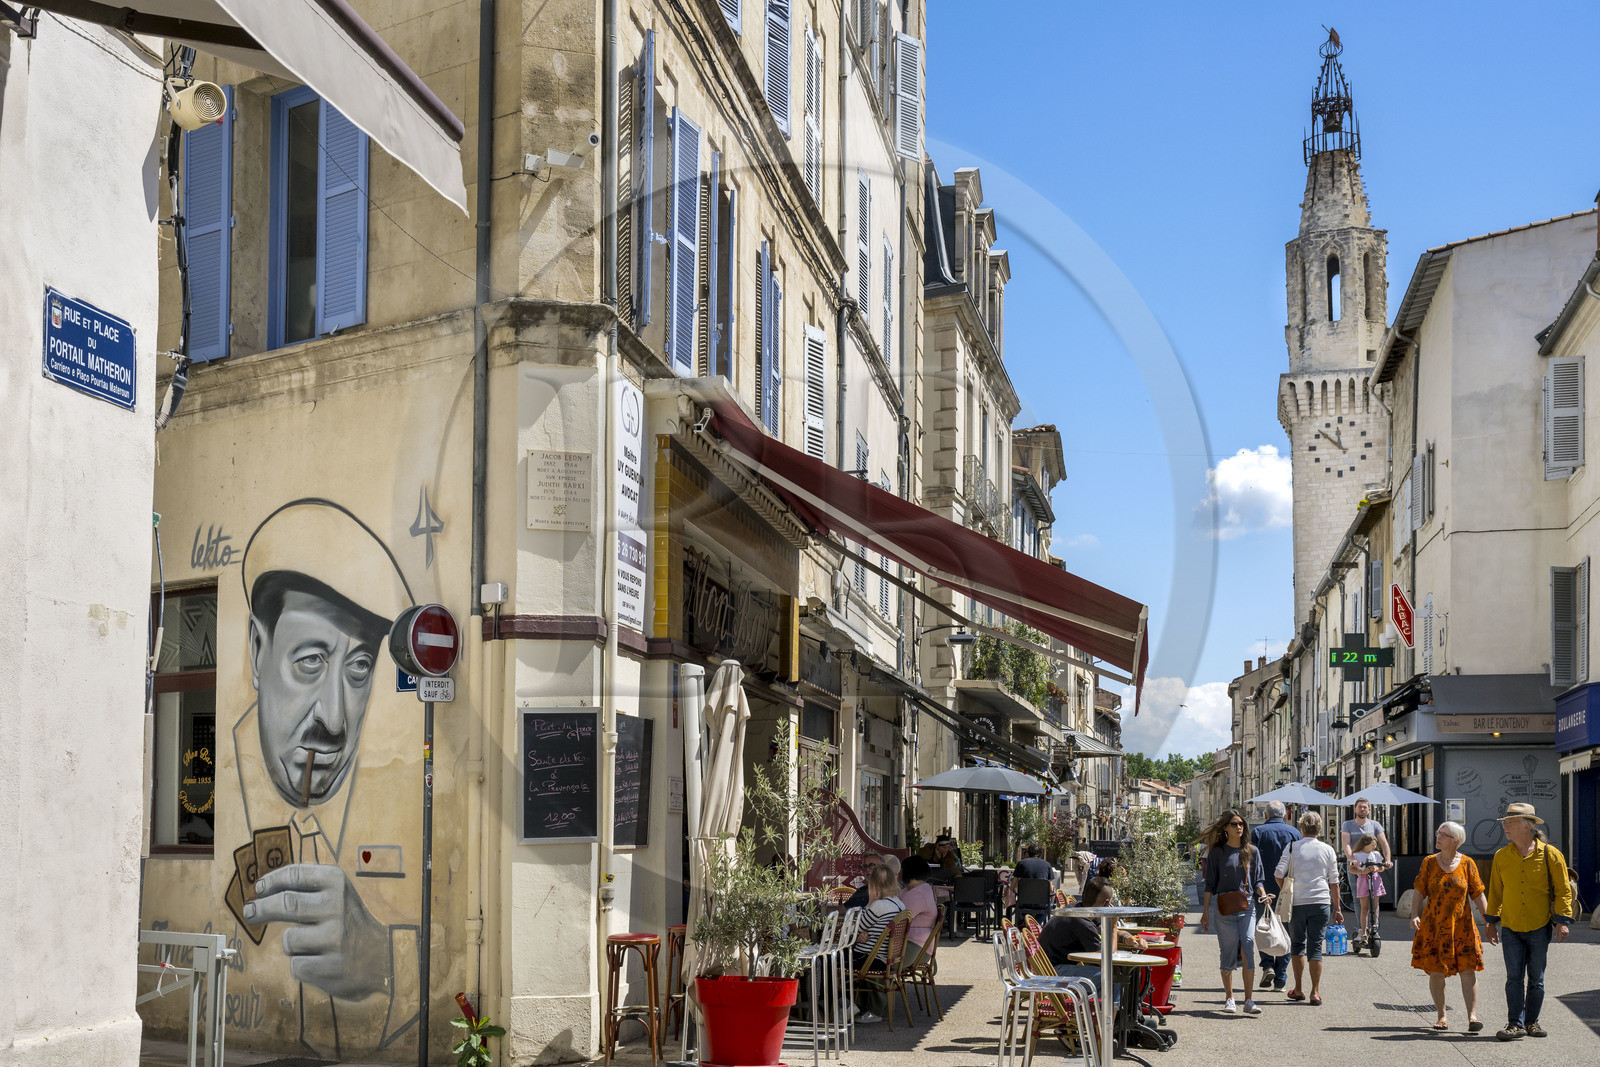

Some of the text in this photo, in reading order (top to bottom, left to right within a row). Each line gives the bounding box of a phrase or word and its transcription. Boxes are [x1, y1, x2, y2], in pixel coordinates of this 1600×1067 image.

[64, 306, 120, 343] RUE ET PLACE
[87, 336, 97, 350] DU
[50, 336, 131, 386] PORTAIL MATHERON
[50, 357, 71, 375] Carriero
[71, 369, 75, 377] e
[621, 483, 639, 504] AVOCAT
[1395, 596, 1412, 635] TABAC
[1342, 652, 1359, 663] 22
[425, 680, 450, 689] INTERDIT
[423, 690, 439, 699] SAUF
[1473, 718, 1486, 729] BAR
[1486, 717, 1495, 729] LE
[1495, 717, 1530, 729] FONTENOY
[1558, 710, 1587, 732] BOULANGERIE
[199, 747, 213, 766] Bar
